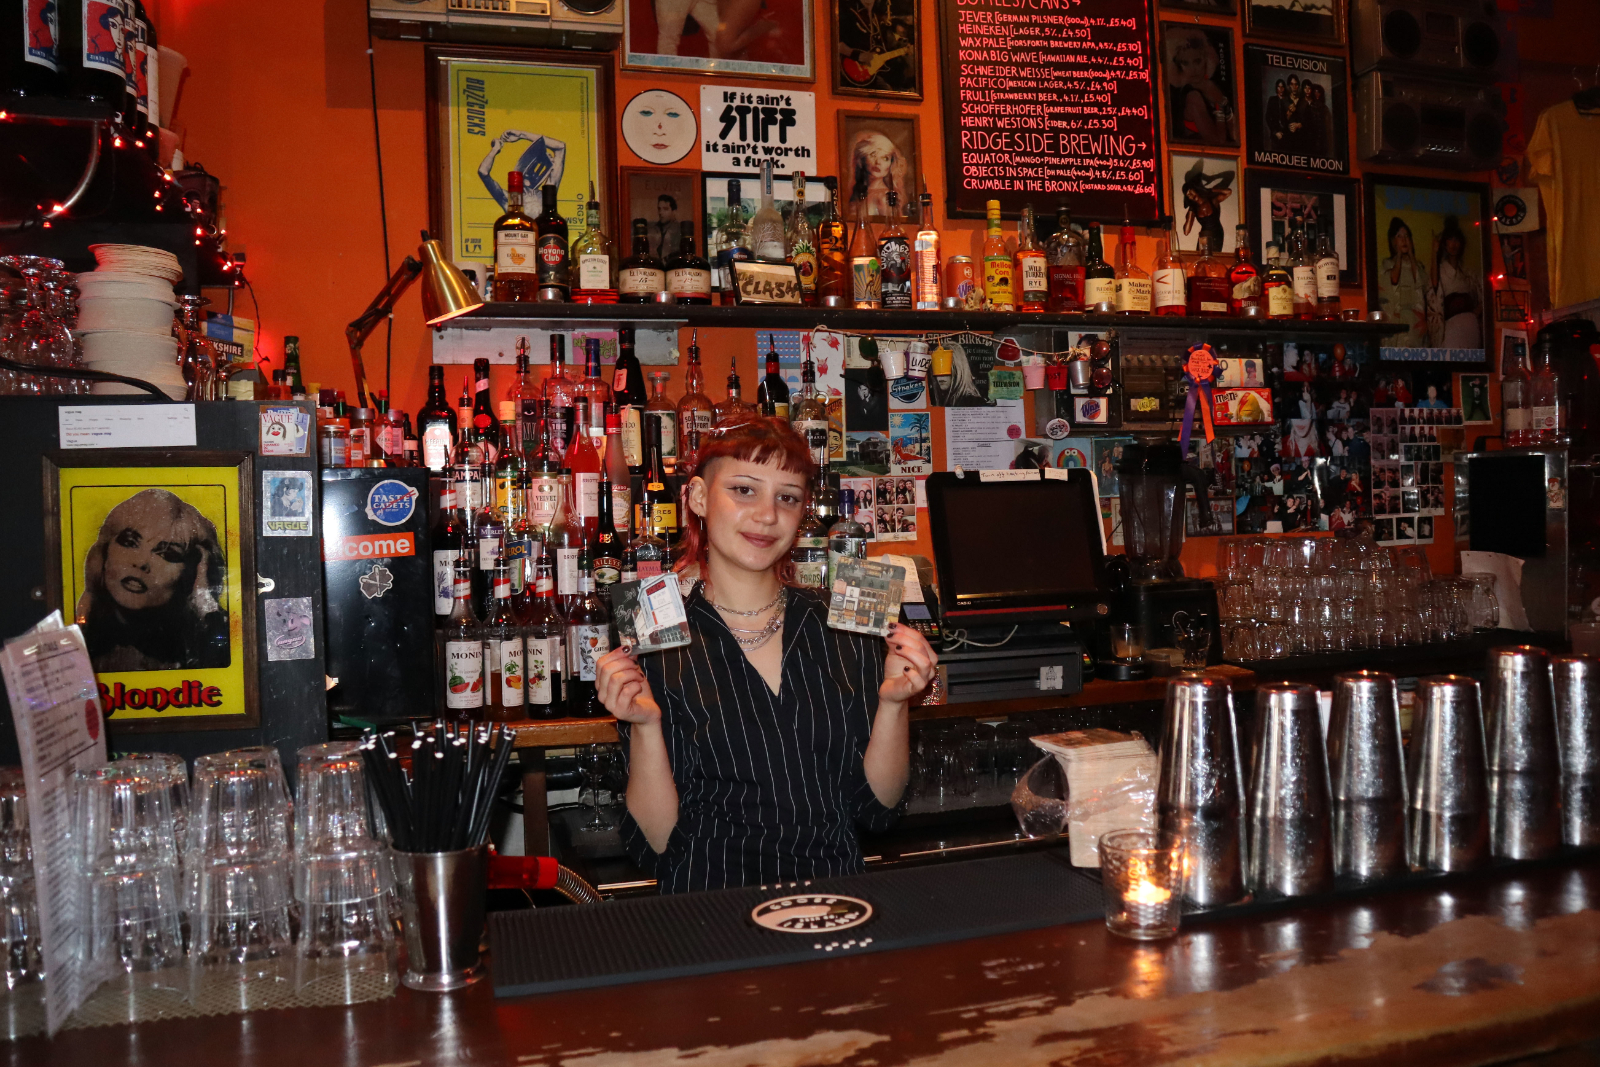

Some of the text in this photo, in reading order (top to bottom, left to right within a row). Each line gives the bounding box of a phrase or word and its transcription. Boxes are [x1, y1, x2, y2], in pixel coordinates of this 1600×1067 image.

[958, 10, 994, 24] JEVER
[958, 23, 1009, 36] HEINEKEN
[959, 37, 981, 48] WAX
[983, 37, 1007, 48] PALE
[1049, 40, 1081, 49] BREWERY
[959, 49, 989, 61] KONA
[990, 50, 1009, 62] BIG
[1010, 51, 1038, 63] WAVE
[1217, 42, 1226, 82] MADONNA
[1266, 53, 1327, 73] TELEVISION
[961, 64, 1018, 77] SCHNEIDER
[1019, 67, 1051, 79] WEISSE
[960, 77, 1006, 88] PACIFICO
[723, 91, 792, 107] If it ain't
[960, 90, 990, 101] FRULI
[464, 77, 488, 136] BUZZCOCKS
[961, 103, 1044, 116] SCHOFFERHOFER
[719, 104, 796, 144] STIFF
[961, 116, 994, 128] HENRY
[995, 117, 1044, 128] WESTONS
[705, 141, 811, 158] it ain't worth
[1060, 133, 1136, 156] BREWING
[732, 156, 785, 169] a fuk.
[962, 152, 1012, 165] EQUATOR
[1255, 151, 1343, 171] MARQUEE MOON
[963, 165, 1004, 178] OBJECTS
[1006, 166, 1017, 177] IN
[1017, 166, 1044, 178] SPACE
[645, 180, 682, 193] ELVIS
[963, 178, 1012, 190] CRUMBLE
[1013, 180, 1023, 191] IN
[1025, 180, 1043, 191] THE
[1045, 180, 1079, 192] BRONX
[1272, 191, 1318, 219] SEX
[539, 246, 565, 256] Havana
[543, 253, 560, 262] Club
[994, 268, 1010, 276] Corn
[1025, 270, 1046, 279] TURKEY
[1027, 264, 1042, 272] WILD
[549, 271, 556, 280] 7
[741, 279, 799, 299] CLASH
[1380, 347, 1485, 362] KIMONO MY HOUSE
[892, 381, 923, 393] Strokes
[262, 414, 293, 424] VAGUE
[901, 465, 923, 474] NICE
[373, 494, 410, 502] TASTE
[373, 501, 410, 509] CADETS
[267, 520, 309, 530] VAGUE
[800, 573, 821, 583] FORDS
[451, 652, 483, 660] MONIN
[769, 897, 837, 910] GOOSE
[783, 911, 859, 929] ISLAND
